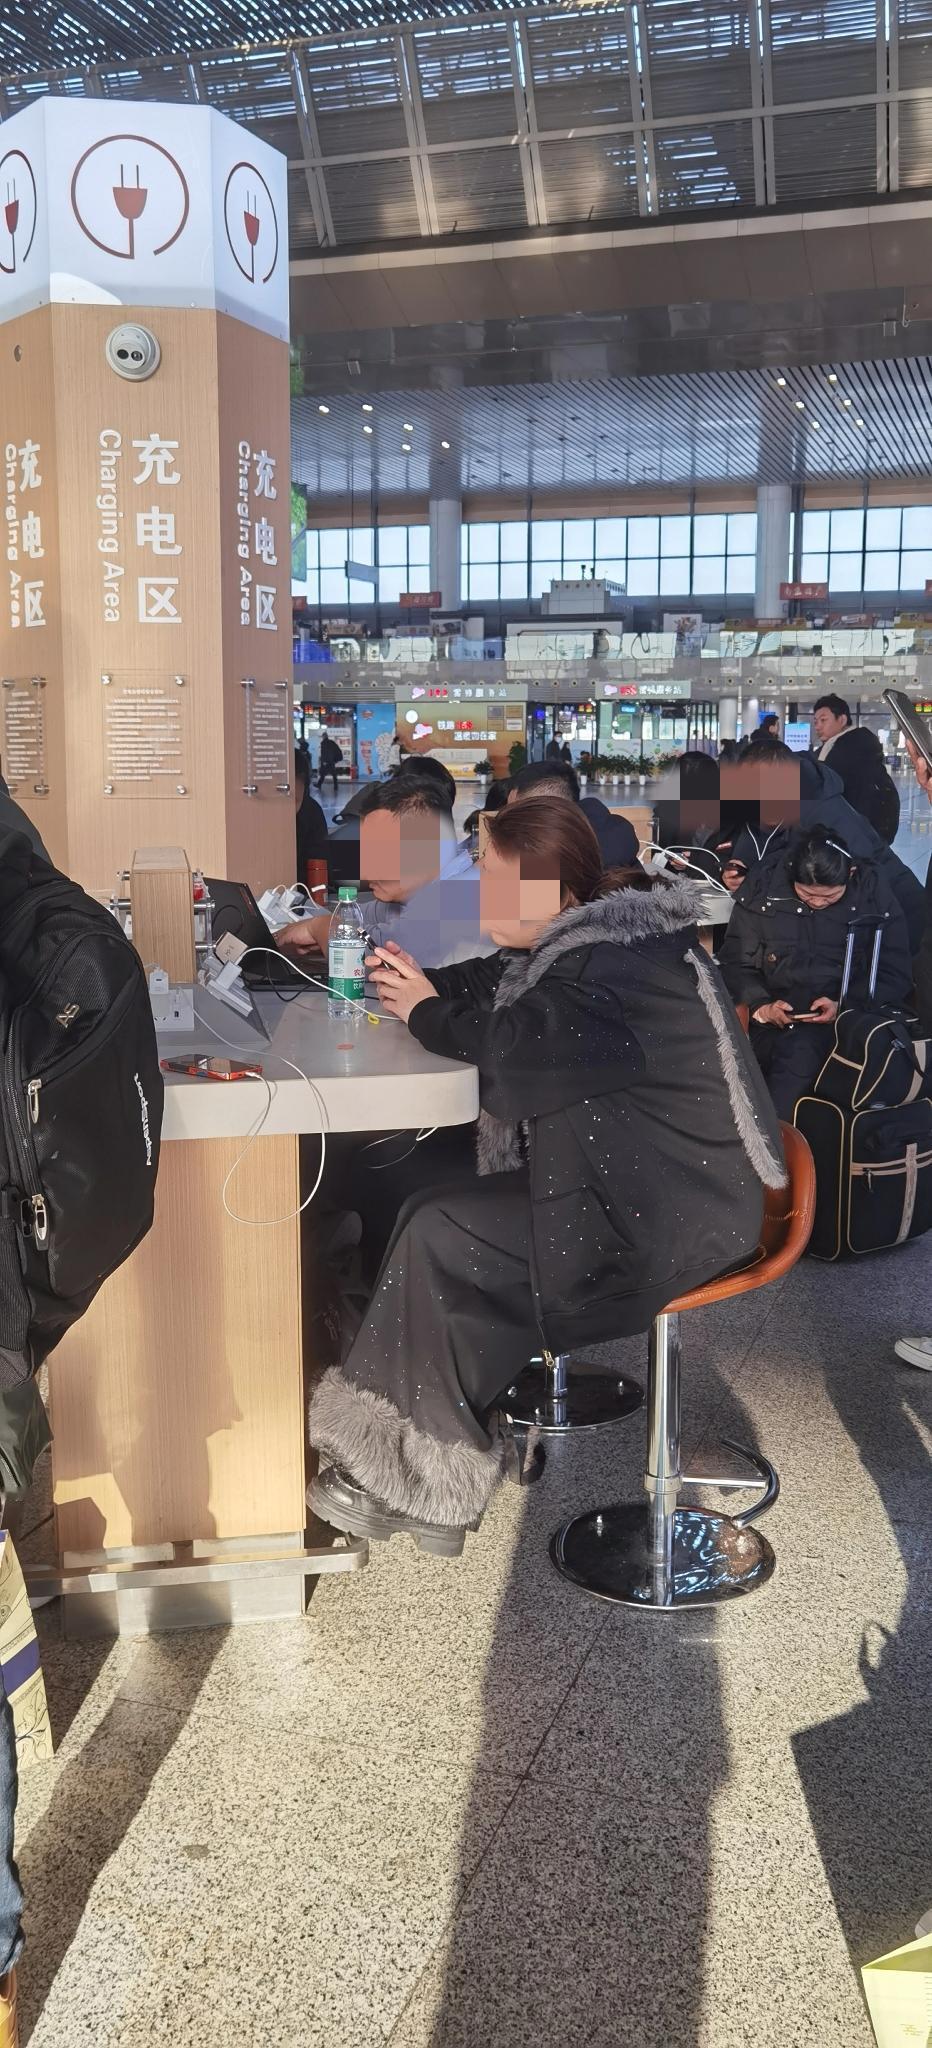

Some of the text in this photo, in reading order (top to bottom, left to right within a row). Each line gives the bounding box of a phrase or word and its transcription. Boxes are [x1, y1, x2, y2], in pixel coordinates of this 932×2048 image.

[5, 443, 21, 628] Charging Area
[18, 439, 46, 627] 充电区
[96, 428, 125, 622] Charging Area
[132, 432, 183, 623] 充电区
[237, 440, 252, 626] Charging Area
[253, 450, 278, 631] 充电区
